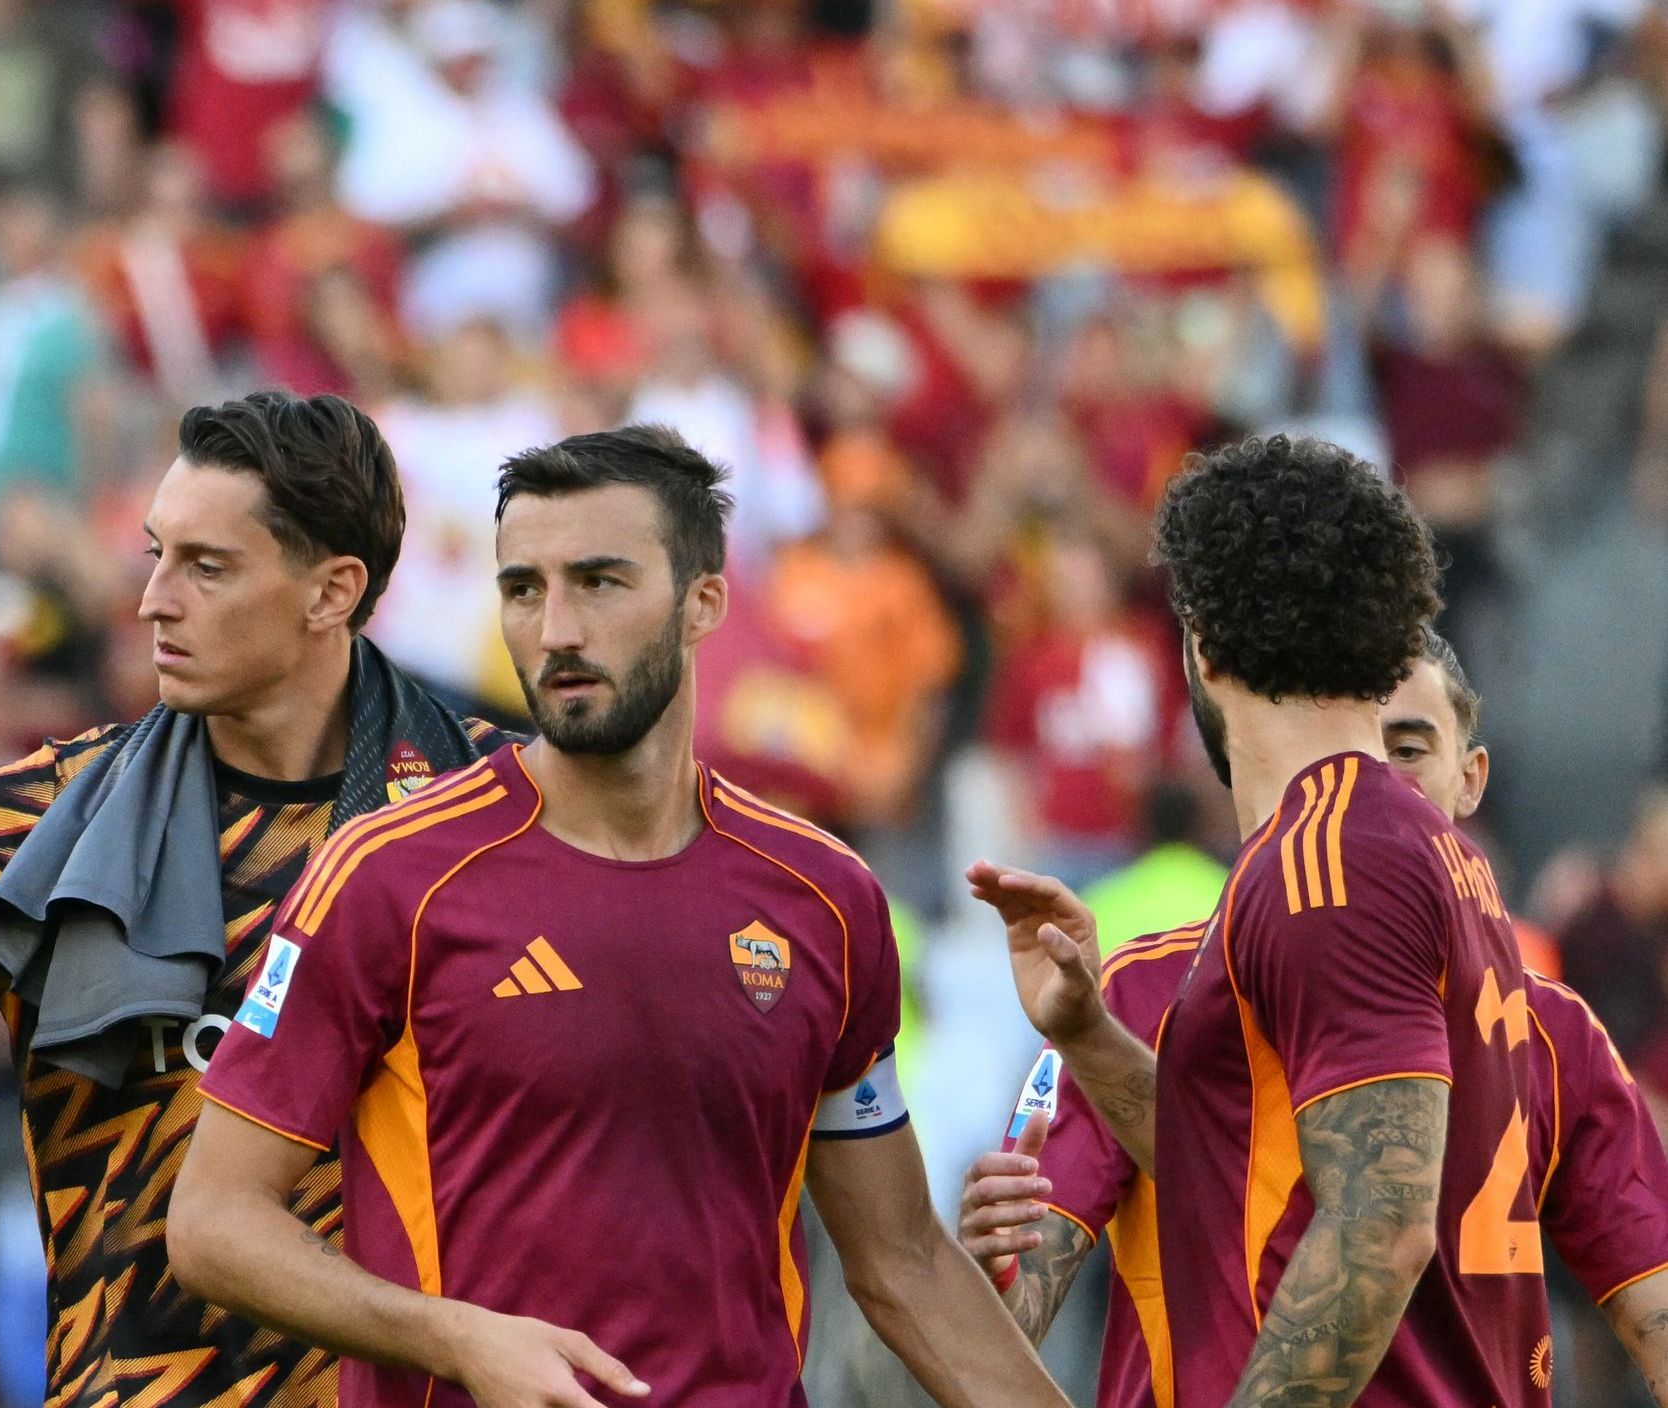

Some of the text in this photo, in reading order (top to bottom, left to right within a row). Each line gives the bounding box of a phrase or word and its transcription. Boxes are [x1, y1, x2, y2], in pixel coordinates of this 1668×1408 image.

[391, 760, 432, 774] ROMA
[742, 970, 785, 989] ROMA
[755, 991, 773, 1001] 1927
[1025, 1098, 1046, 1109] SERIE
